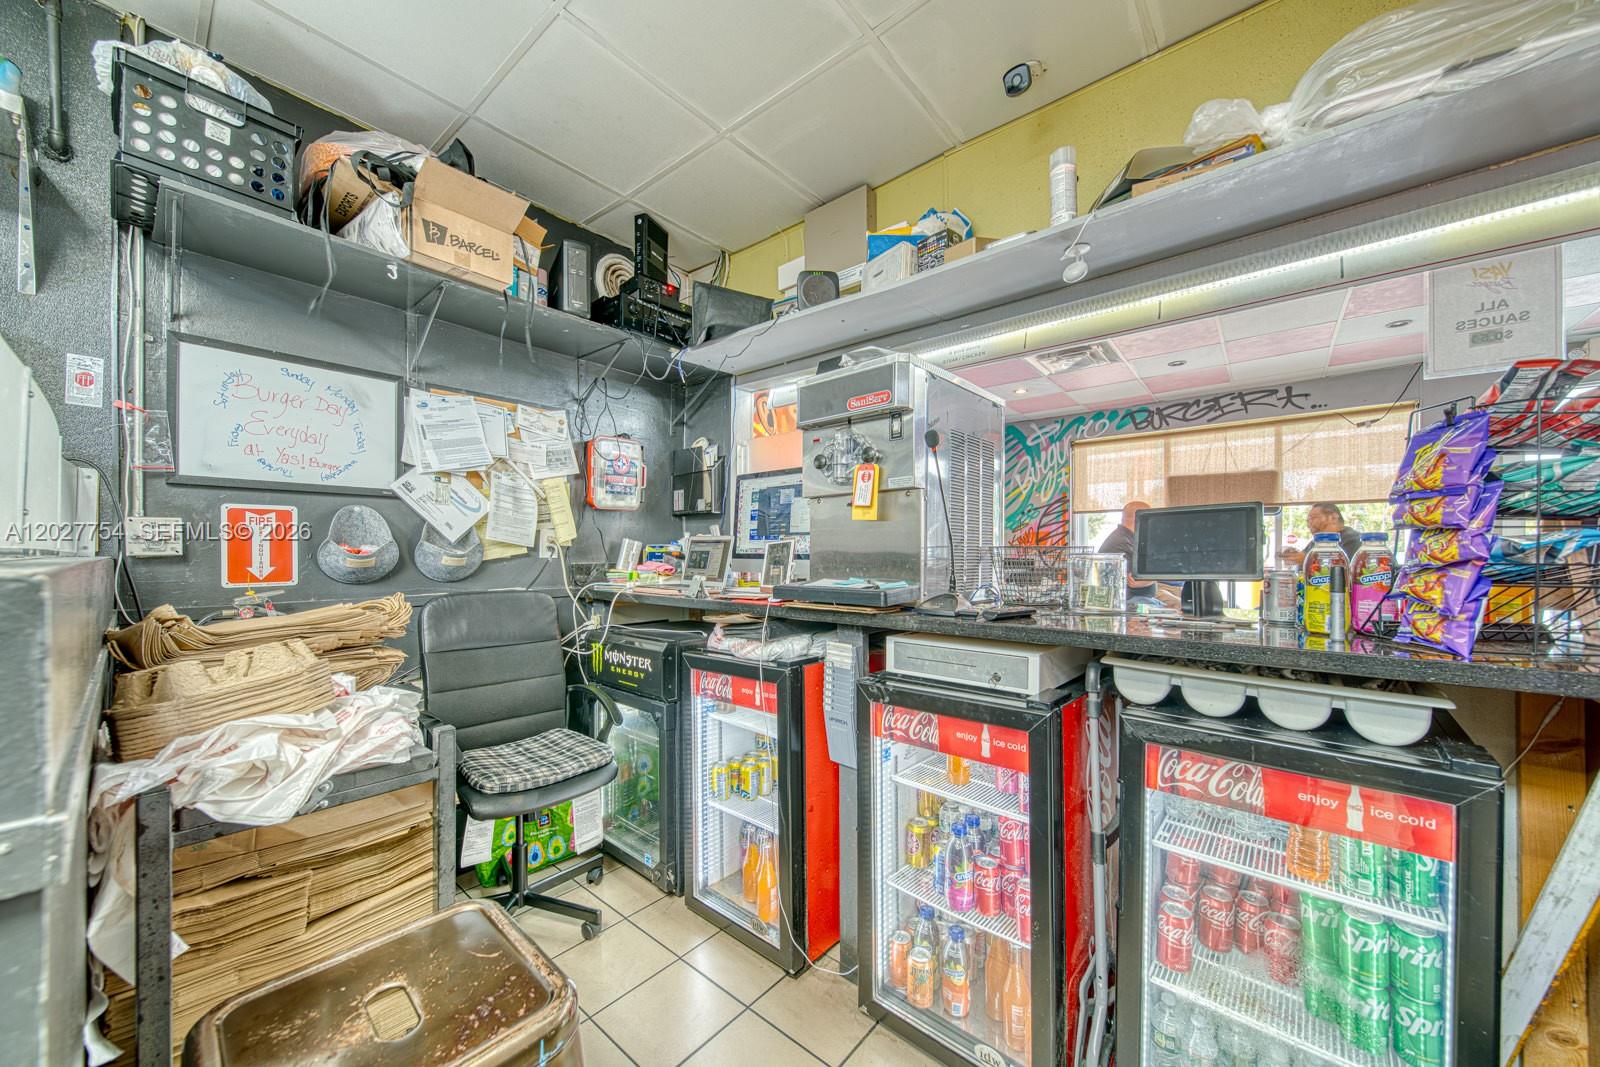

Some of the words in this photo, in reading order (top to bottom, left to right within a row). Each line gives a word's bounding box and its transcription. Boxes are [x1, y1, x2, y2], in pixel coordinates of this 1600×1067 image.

[449, 234, 500, 261] BARCEL
[280, 367, 316, 392] Sunday
[231, 373, 305, 419] Burger
[313, 396, 350, 427] Day
[244, 410, 329, 454] Everyday
[248, 516, 273, 526] FIRE
[604, 649, 653, 672] MONSTER
[610, 665, 645, 680] ENERGY
[956, 730, 978, 743] enjoy
[992, 737, 1005, 748] ice
[1007, 742, 1027, 753] cold
[1297, 791, 1340, 809] enjoy
[1369, 806, 1394, 821] ice
[1398, 812, 1437, 831] cold
